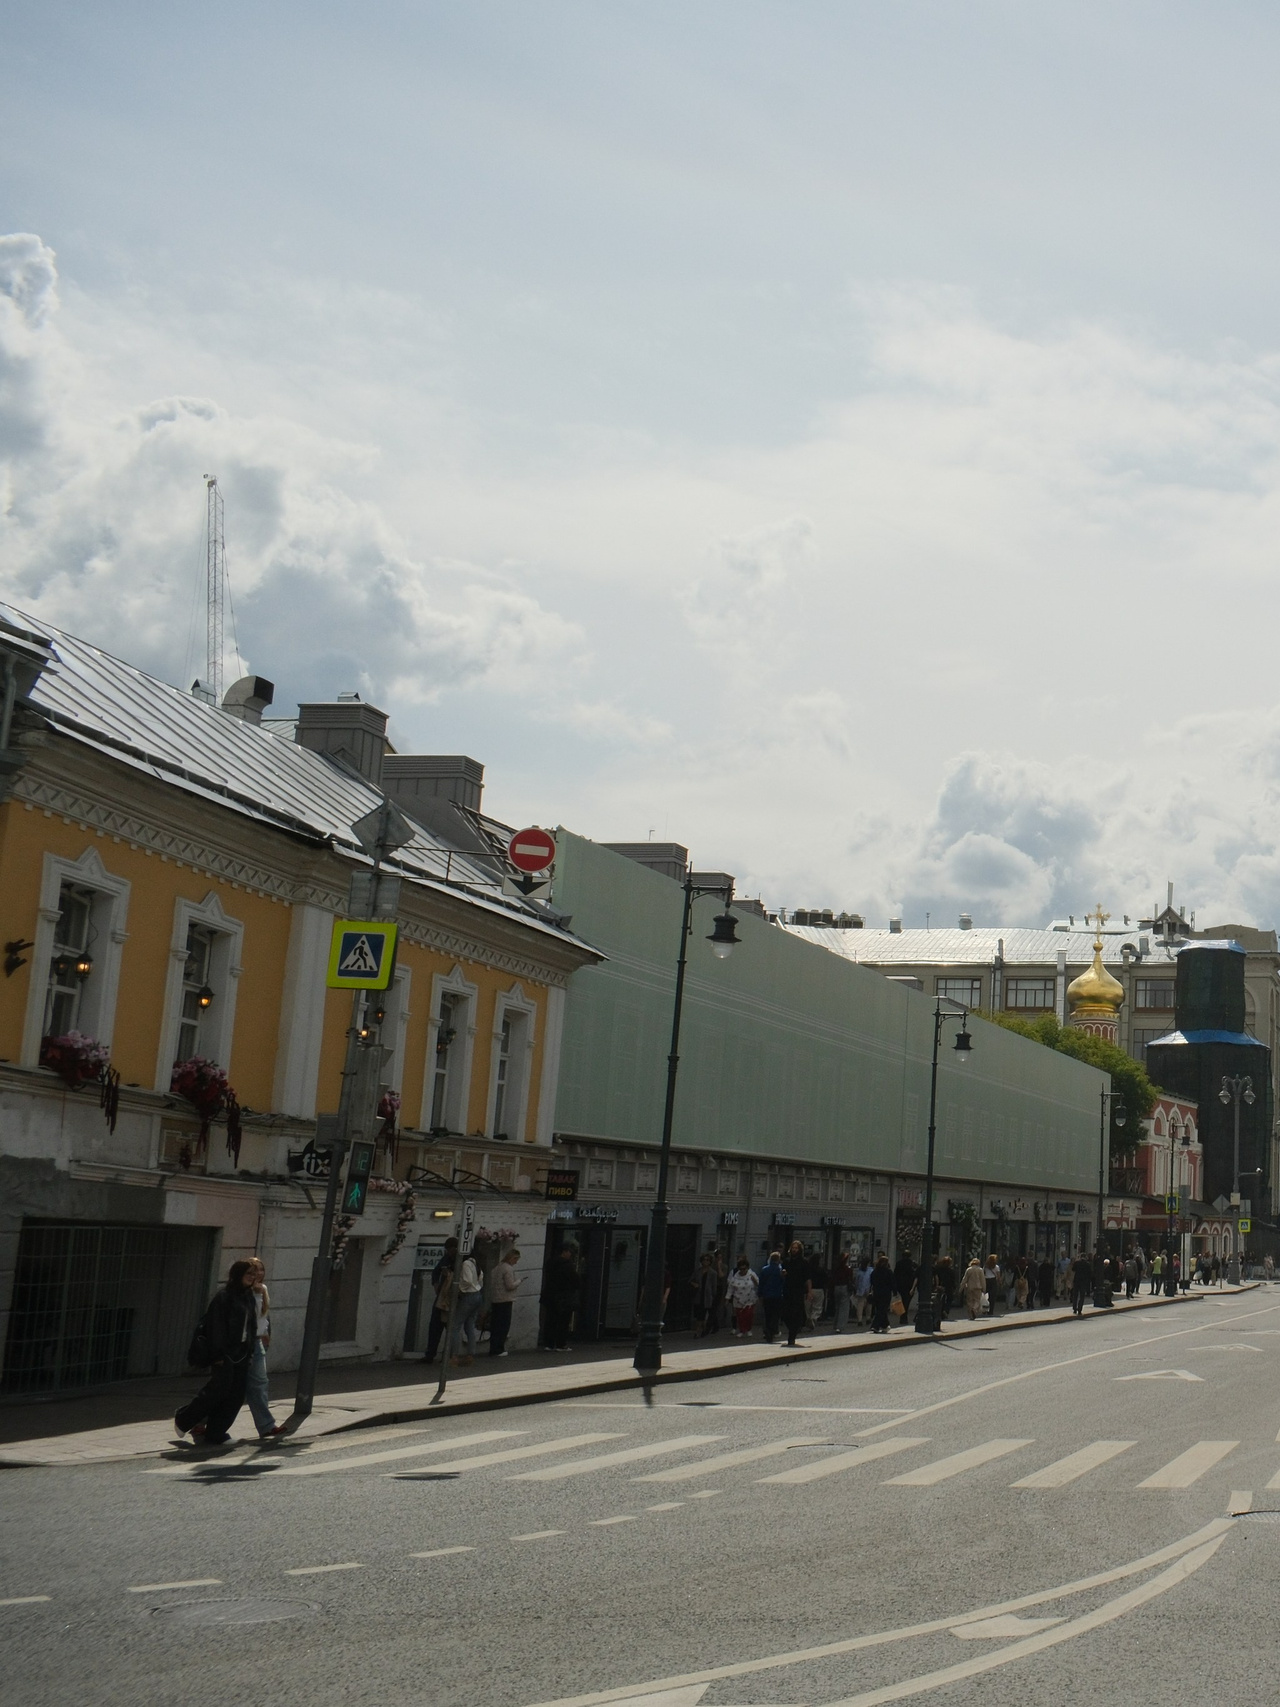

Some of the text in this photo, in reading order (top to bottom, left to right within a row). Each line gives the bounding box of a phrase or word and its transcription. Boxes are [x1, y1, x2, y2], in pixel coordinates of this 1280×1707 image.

[302, 1153, 331, 1174] fix
[548, 1173, 577, 1184] ТАБАК
[548, 1187, 573, 1196] ПИВО
[724, 1212, 739, 1225] PIMS
